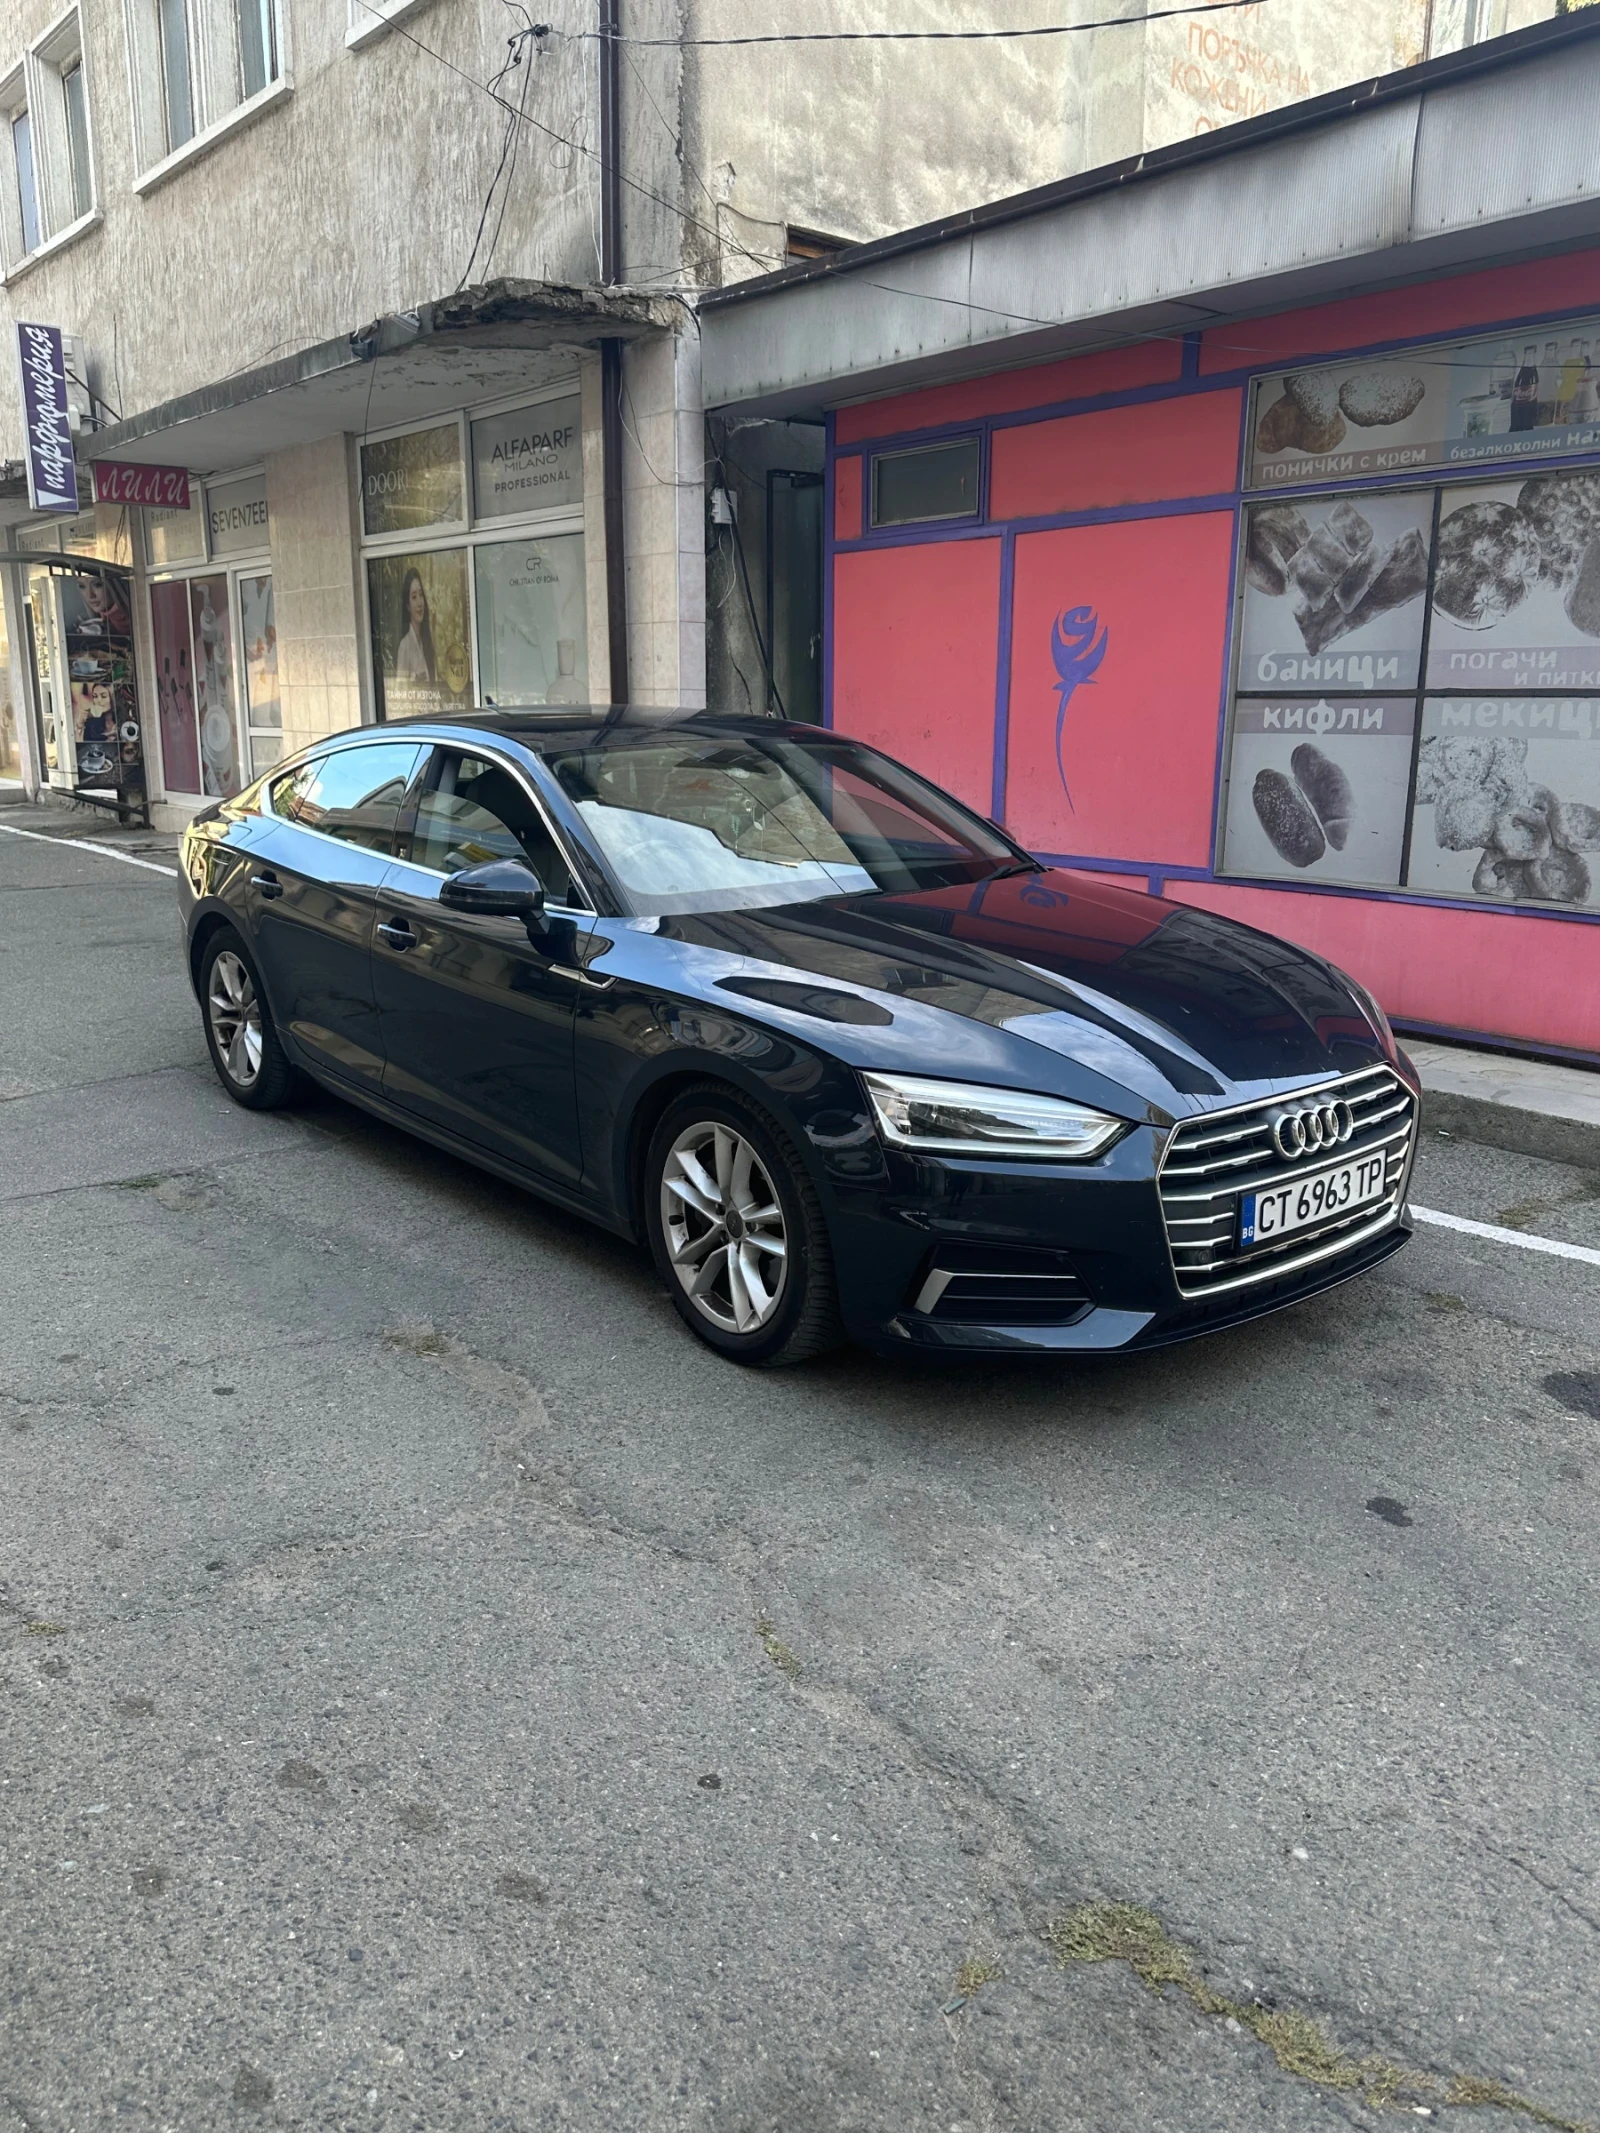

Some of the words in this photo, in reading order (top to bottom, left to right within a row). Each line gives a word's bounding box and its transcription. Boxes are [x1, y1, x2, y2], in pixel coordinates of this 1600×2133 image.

[1171, 57, 1267, 116] КОЖЕНИ
[24, 326, 72, 489] парфюмерия
[491, 427, 573, 464] ALFAPARF
[1451, 437, 1561, 460] безалкохолни
[504, 454, 558, 472] MILANO
[1262, 455, 1353, 480] понички
[1360, 455, 1370, 468] с
[1376, 449, 1426, 468] крем
[494, 470, 571, 493] PROFESSIONAL
[1257, 649, 1399, 689] баници
[1450, 651, 1557, 669] погачи
[1514, 672, 1528, 685] и
[1263, 698, 1384, 737] кифли
[1441, 701, 1600, 740] мекиц
[1259, 1189, 1292, 1233] CT
[1297, 1170, 1351, 1220] 6963
[1357, 1157, 1382, 1199] TP
[1242, 1226, 1254, 1239] BG
